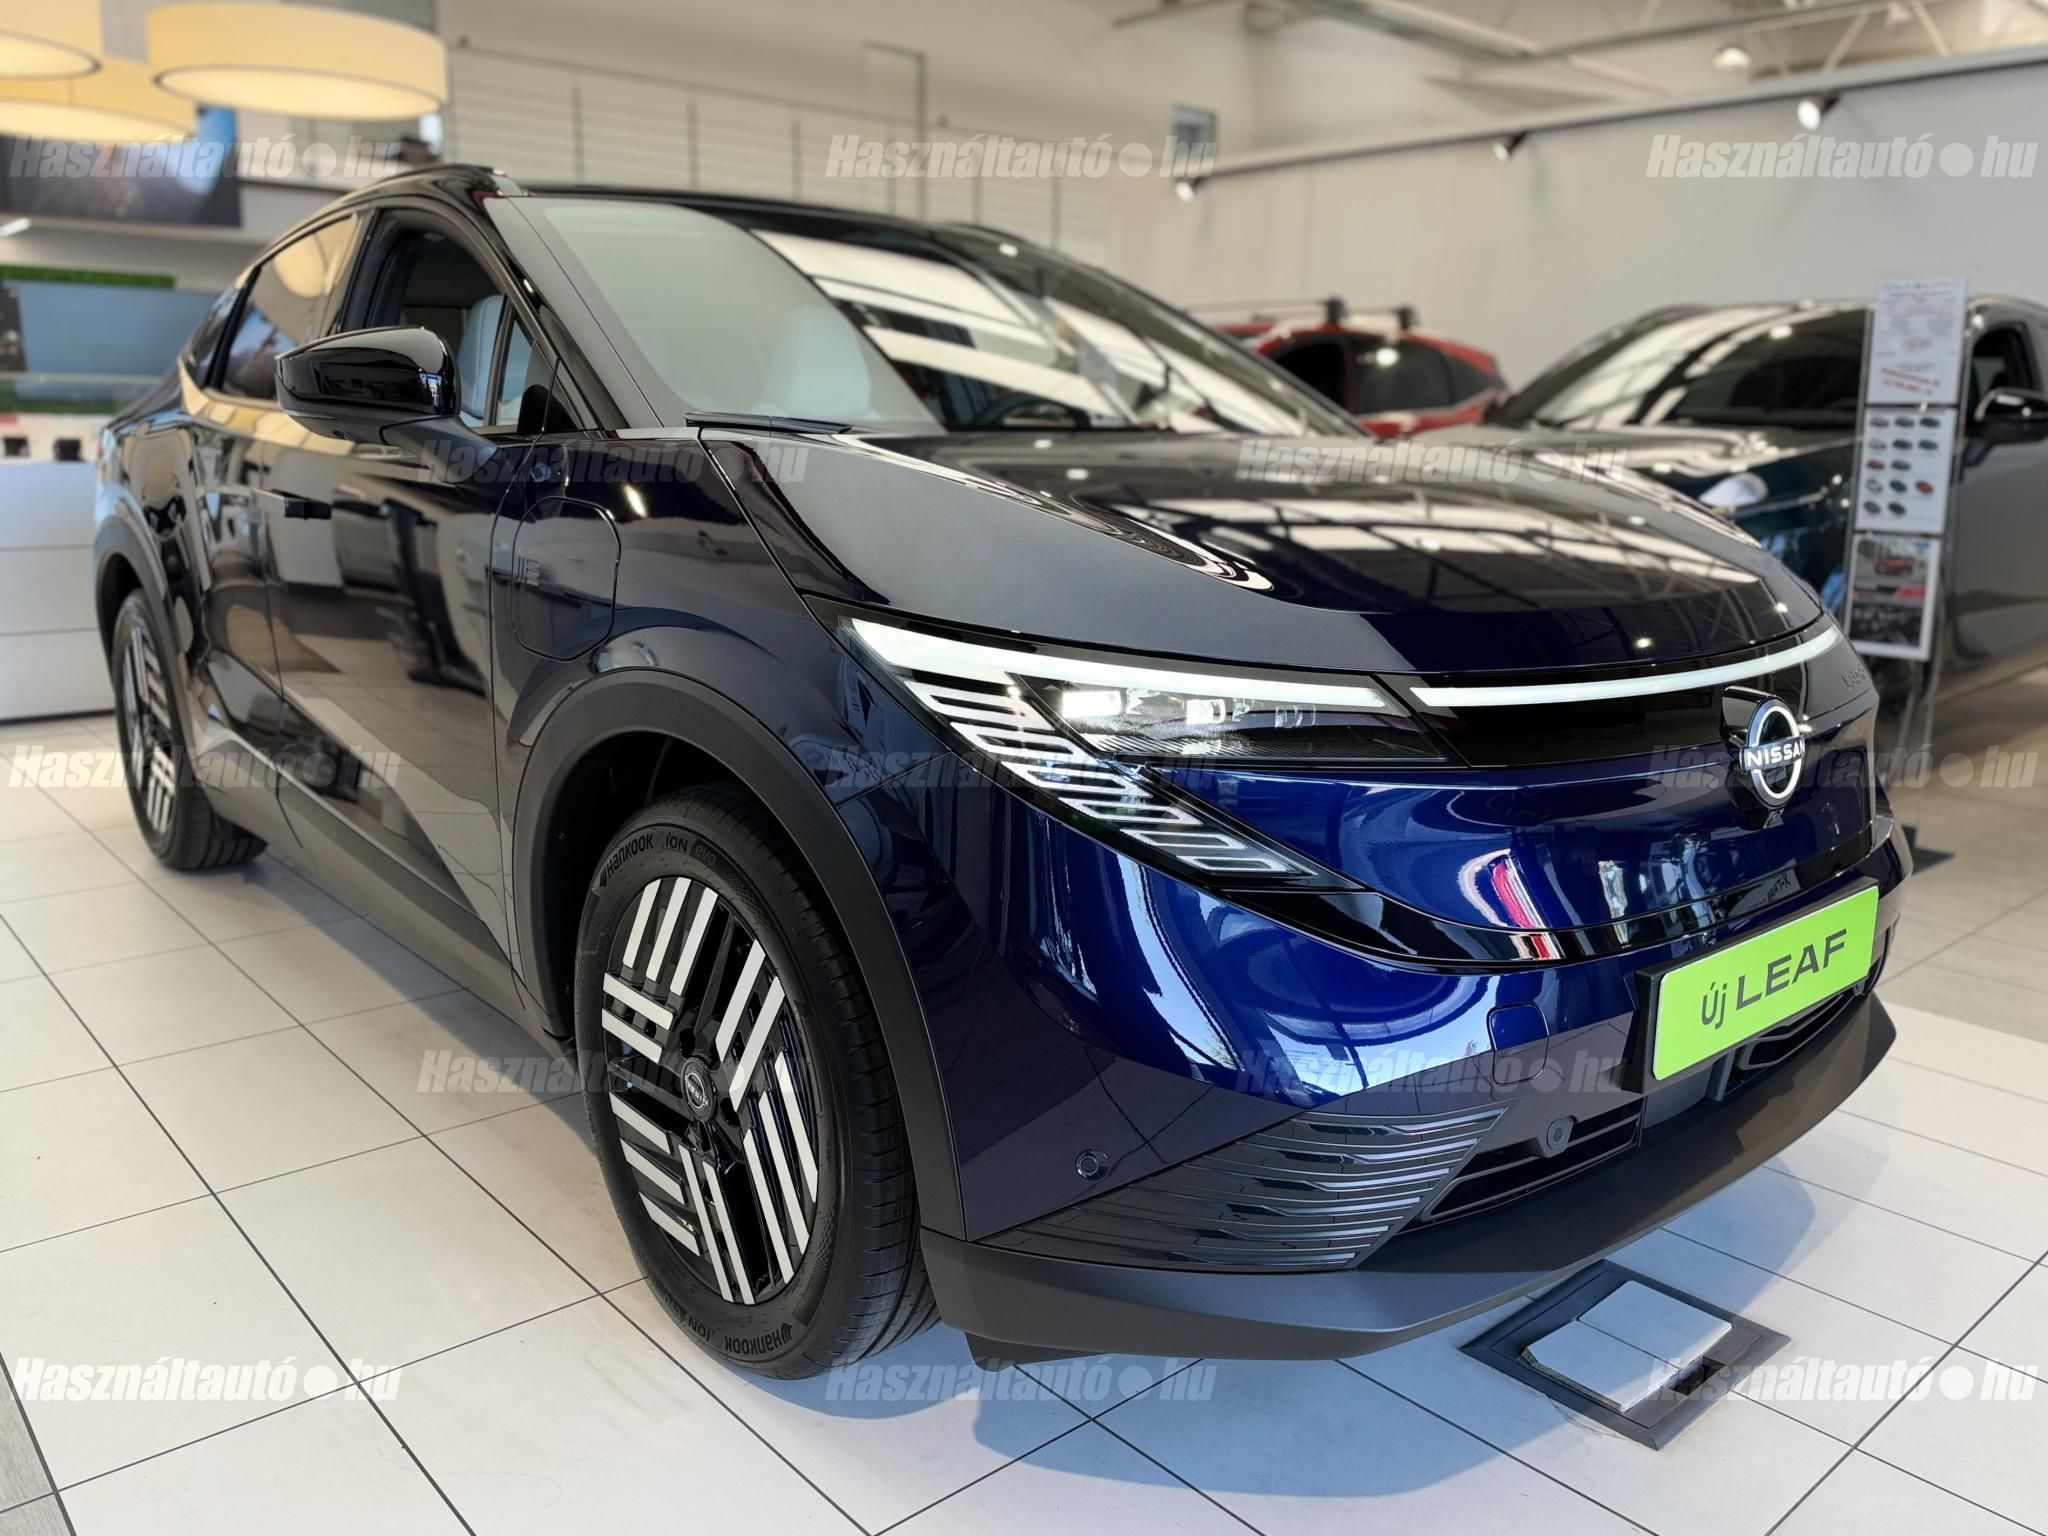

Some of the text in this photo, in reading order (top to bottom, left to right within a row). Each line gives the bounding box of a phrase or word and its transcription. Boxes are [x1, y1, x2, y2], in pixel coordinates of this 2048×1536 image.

[1746, 739, 1805, 768] NISSAN
[1701, 928, 1847, 1030] Új LEAF
